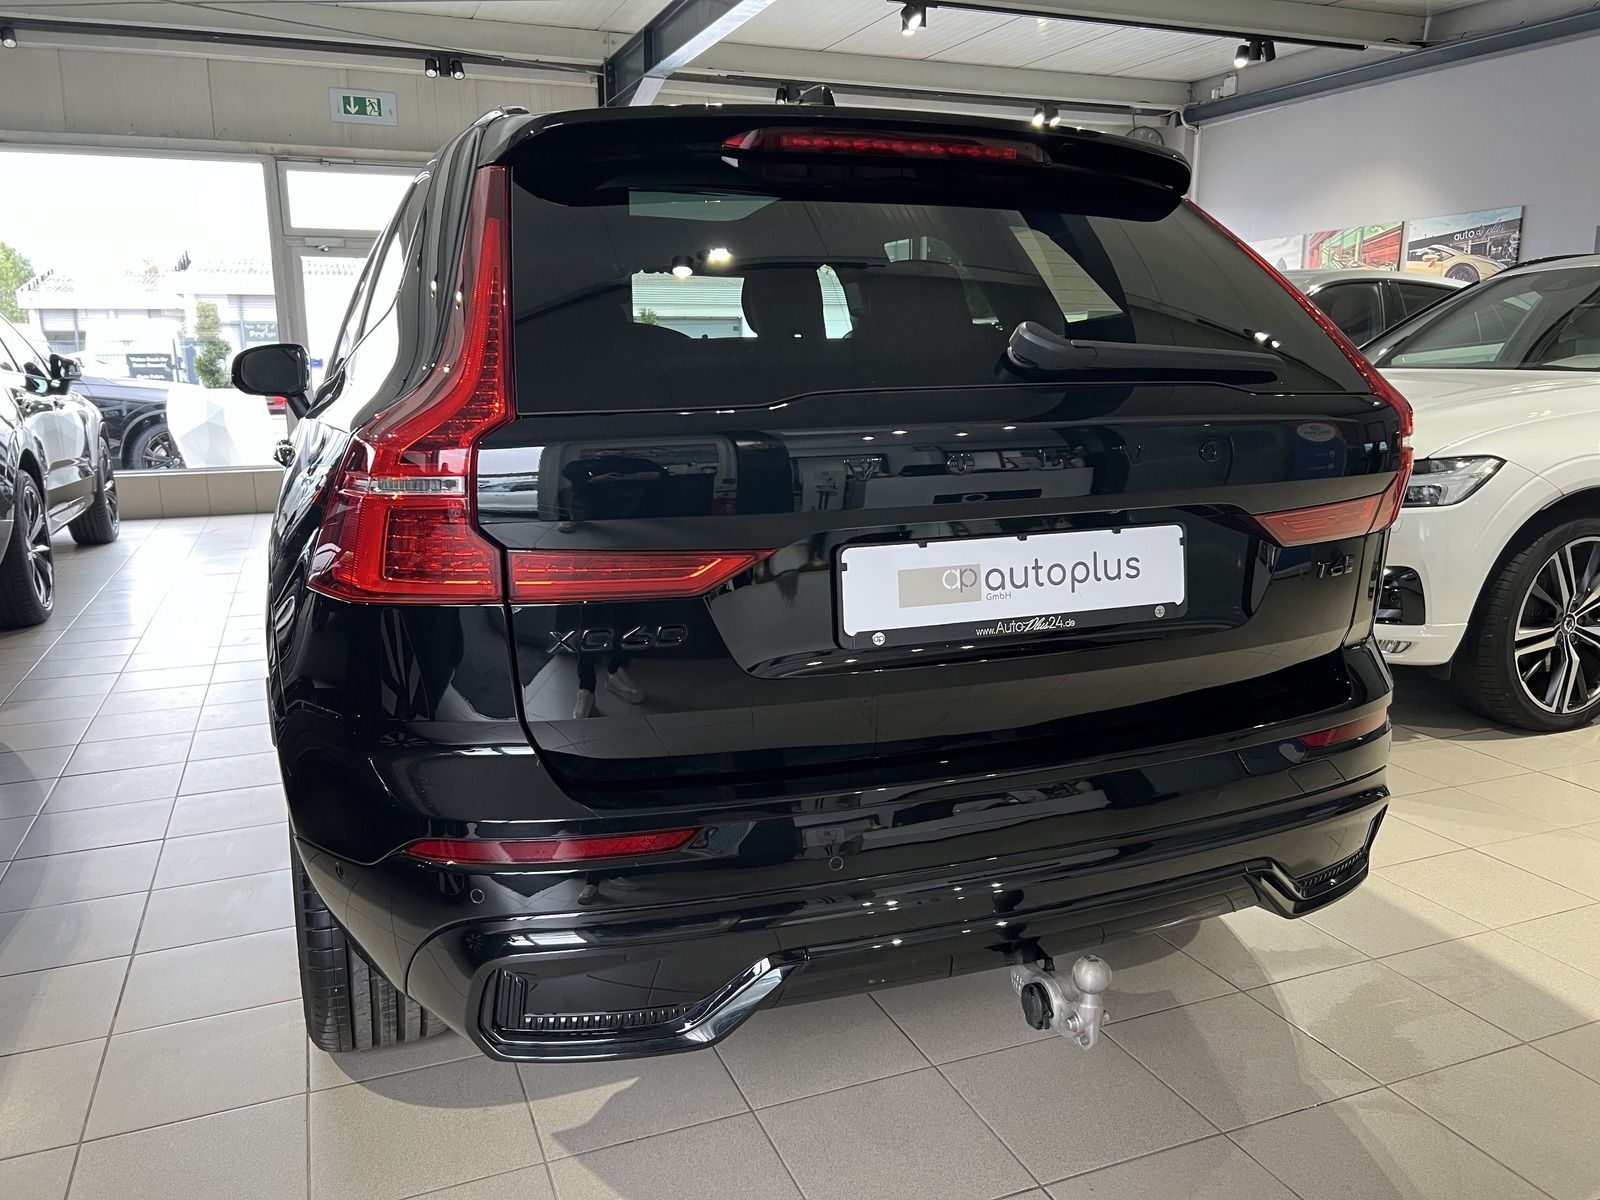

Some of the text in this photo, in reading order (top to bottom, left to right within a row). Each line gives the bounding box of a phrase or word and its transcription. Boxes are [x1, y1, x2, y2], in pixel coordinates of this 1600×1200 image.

[1453, 230, 1475, 241] auto
[984, 551, 1141, 593] autoplus
[985, 591, 1012, 602] GmbH
[547, 625, 688, 653] XC60
